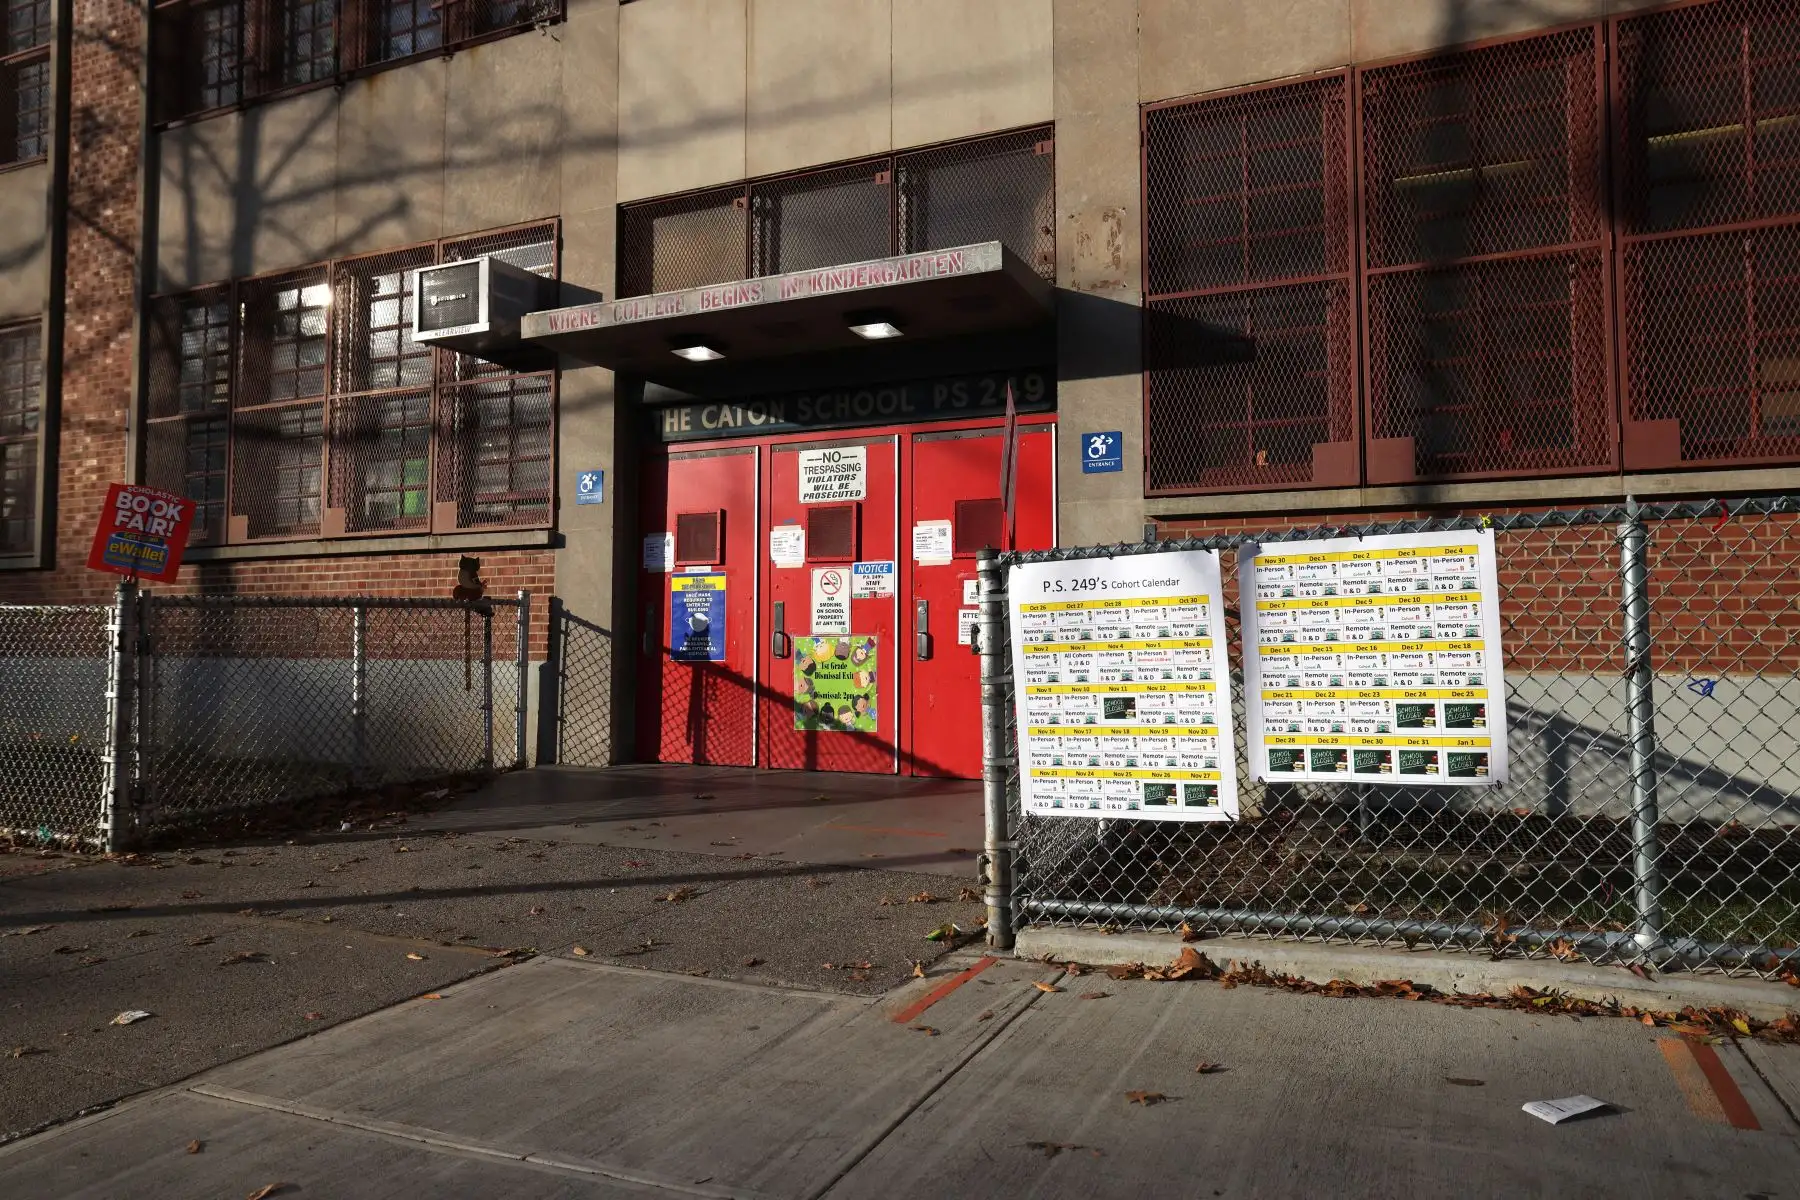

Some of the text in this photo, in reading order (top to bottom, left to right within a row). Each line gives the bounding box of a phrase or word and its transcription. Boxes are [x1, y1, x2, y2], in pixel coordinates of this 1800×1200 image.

[549, 252, 963, 332] WHERE COLLEGE BEGINS IN KINDERGARTEN
[662, 407, 692, 432] HE
[701, 399, 784, 429] CATON
[798, 389, 914, 421] SCHOOL
[934, 380, 969, 409] PS
[804, 463, 862, 475] TRESPASSING
[807, 474, 856, 483] VIOLATORS
[803, 490, 861, 500] PROSECUTED
[116, 491, 184, 521] BOOK
[114, 510, 176, 537] FAIR!
[110, 542, 165, 562] eWallet
[858, 564, 888, 573] NOTICE
[1043, 577, 1180, 592] P.S. 249's Cohort Calendar
